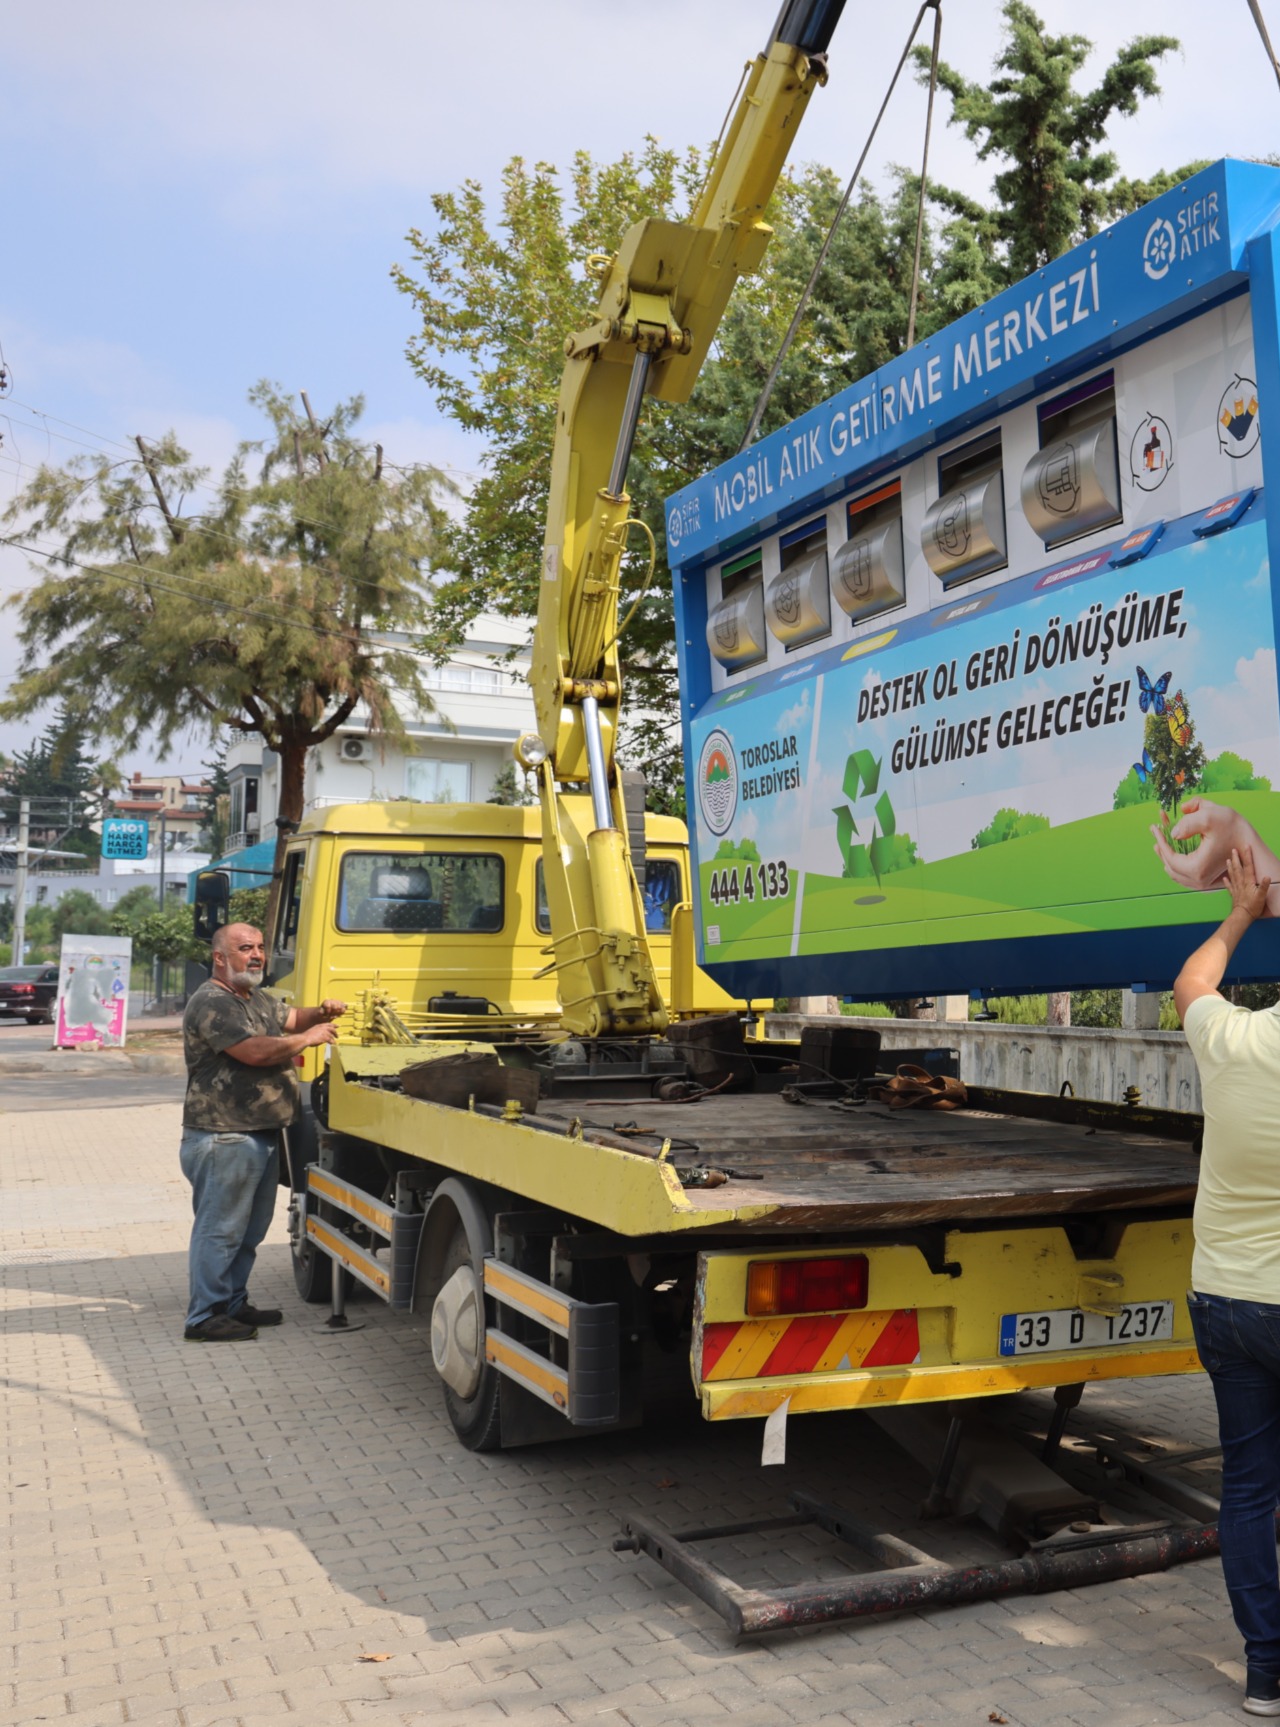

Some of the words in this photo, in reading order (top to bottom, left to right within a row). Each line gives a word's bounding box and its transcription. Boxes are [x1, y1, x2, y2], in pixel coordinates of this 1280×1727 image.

[1177, 191, 1219, 234] SIFIR
[1180, 215, 1221, 261] ATIK
[713, 451, 774, 523] MOBİL
[779, 427, 822, 487] ATIK
[829, 355, 943, 457] GETİRME
[953, 249, 1100, 391] MERKEZİ
[682, 497, 700, 520] SIFIR
[683, 514, 701, 537] ATIK
[857, 669, 929, 723] DESTEK
[932, 660, 958, 702] OL
[965, 629, 1020, 692] GERİ
[1023, 588, 1188, 666] DÖNÜŞÜME,
[891, 715, 992, 775] GÜLÜMSE
[996, 674, 1131, 750] GELECEĞE!
[740, 735, 798, 770] TOROSLAR
[742, 760, 801, 801] BELEDİYESİ
[107, 832, 143, 841] HARCA
[107, 840, 143, 849] HARCA
[710, 866, 740, 905] 444
[743, 864, 755, 901] 4
[758, 860, 790, 899] 133
[1003, 1337, 1015, 1347] TR
[1019, 1316, 1051, 1348] 33
[1069, 1313, 1085, 1344] D
[1105, 1305, 1165, 1340] 1237
